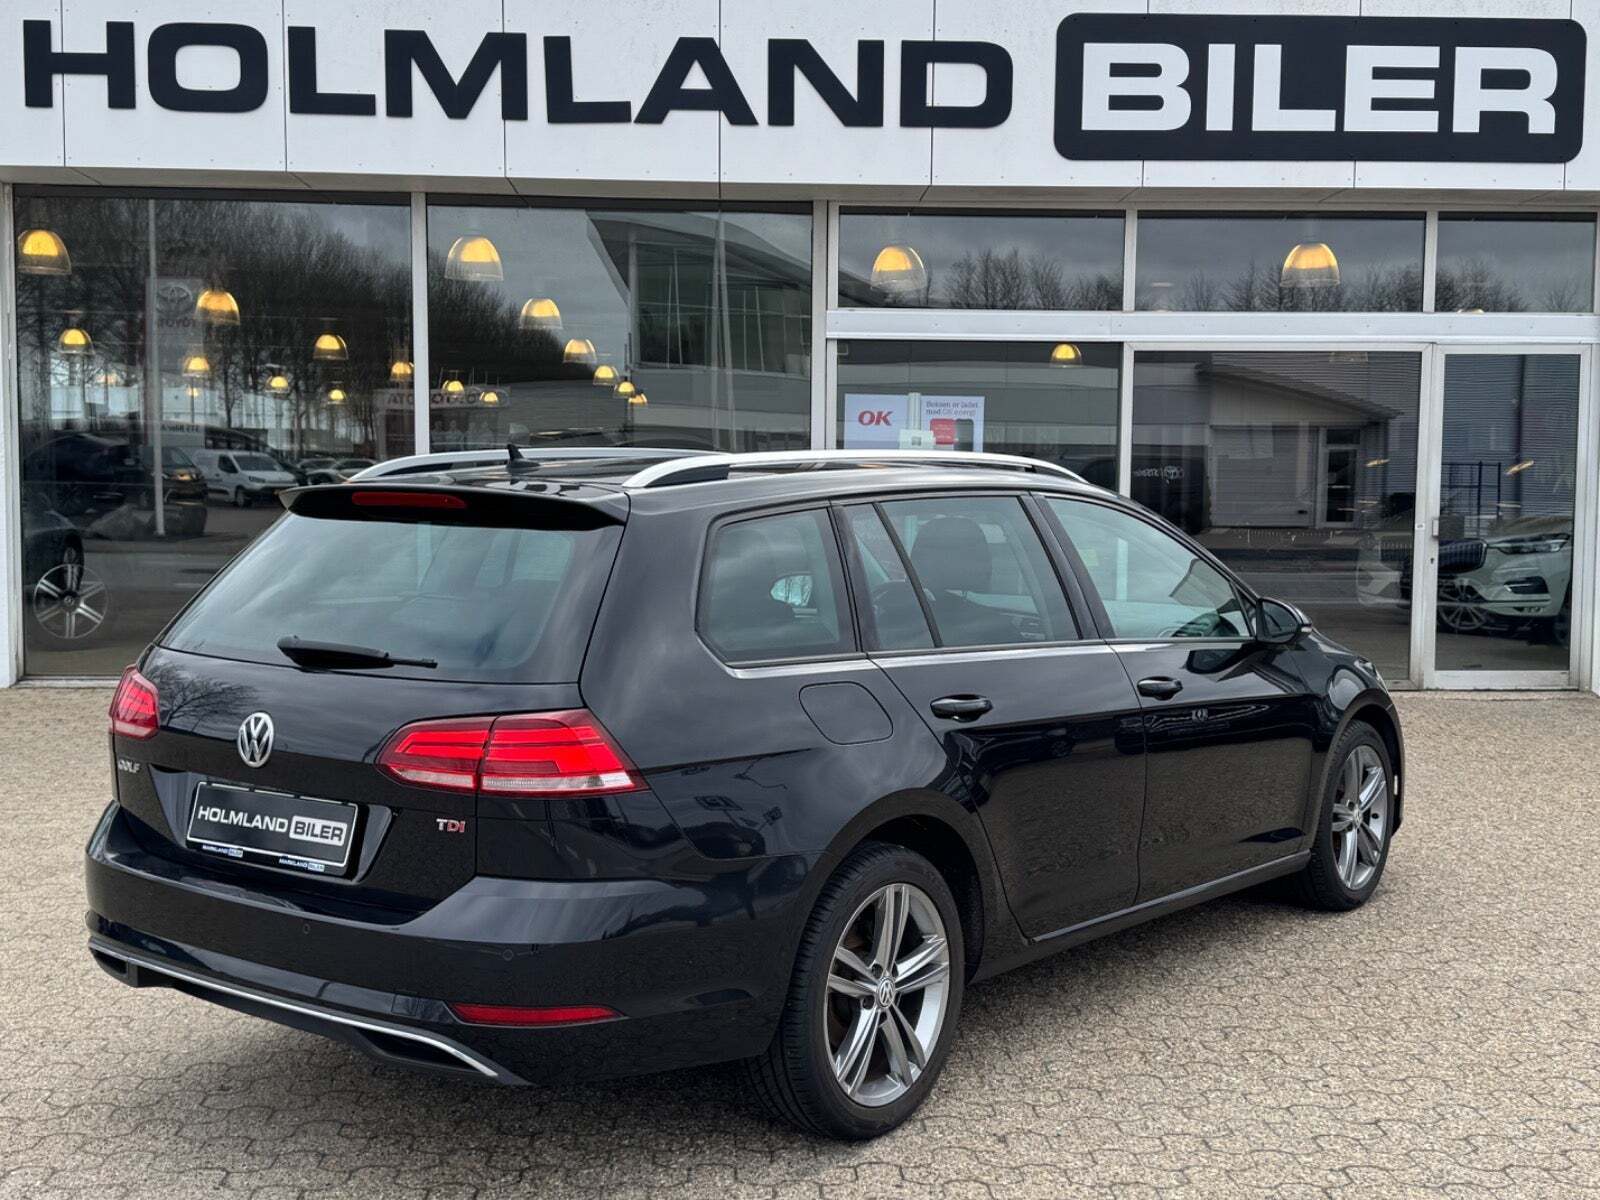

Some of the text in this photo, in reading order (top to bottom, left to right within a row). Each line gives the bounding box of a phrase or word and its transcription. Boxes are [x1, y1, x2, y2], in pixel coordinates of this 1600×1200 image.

[24, 20, 1557, 133] HOLMLAND BILER
[858, 410, 894, 426] OK
[197, 805, 344, 842] HOLMLAND BILER
